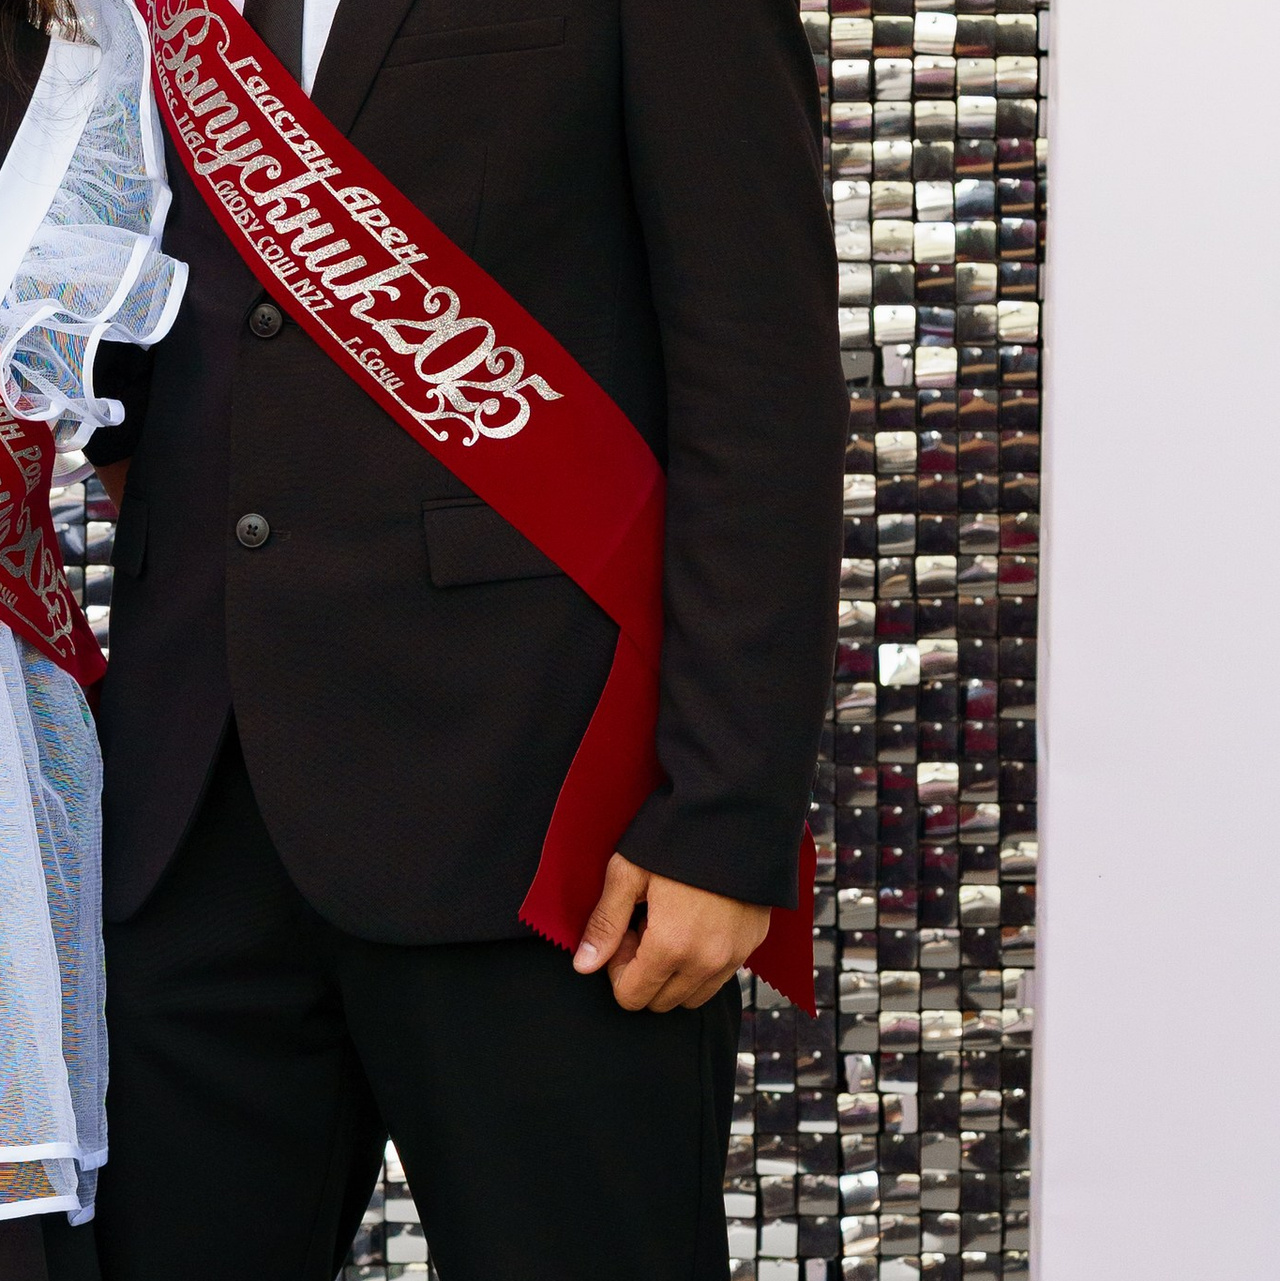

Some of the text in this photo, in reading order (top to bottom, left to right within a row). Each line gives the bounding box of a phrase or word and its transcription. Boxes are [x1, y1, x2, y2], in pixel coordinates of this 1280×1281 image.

[257, 236, 300, 282] СОШ
[336, 187, 428, 268] Арен
[373, 285, 563, 438] 2025
